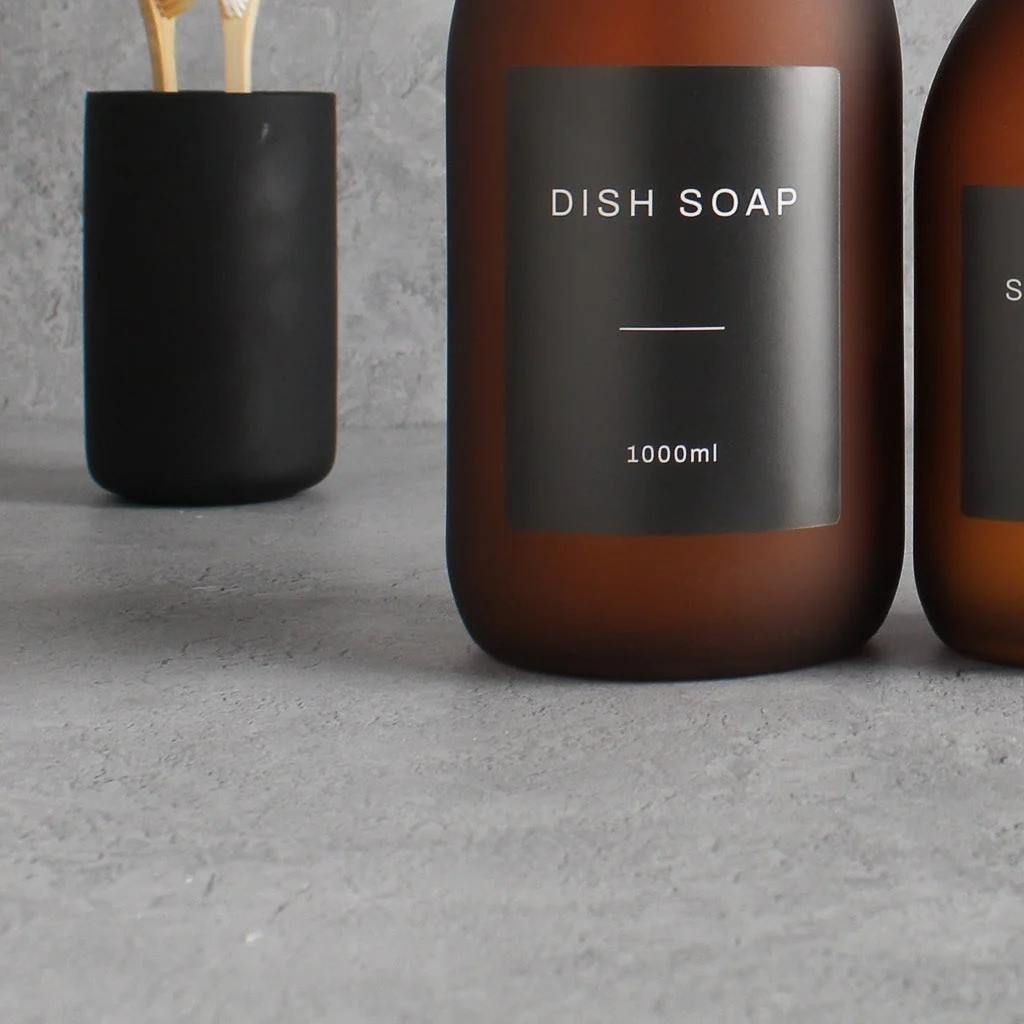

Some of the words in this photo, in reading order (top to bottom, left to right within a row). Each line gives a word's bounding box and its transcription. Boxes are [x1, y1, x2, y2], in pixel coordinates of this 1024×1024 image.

[551, 187, 654, 217] DISH
[679, 187, 798, 217] SOAP
[626, 442, 718, 464] 1000ml
